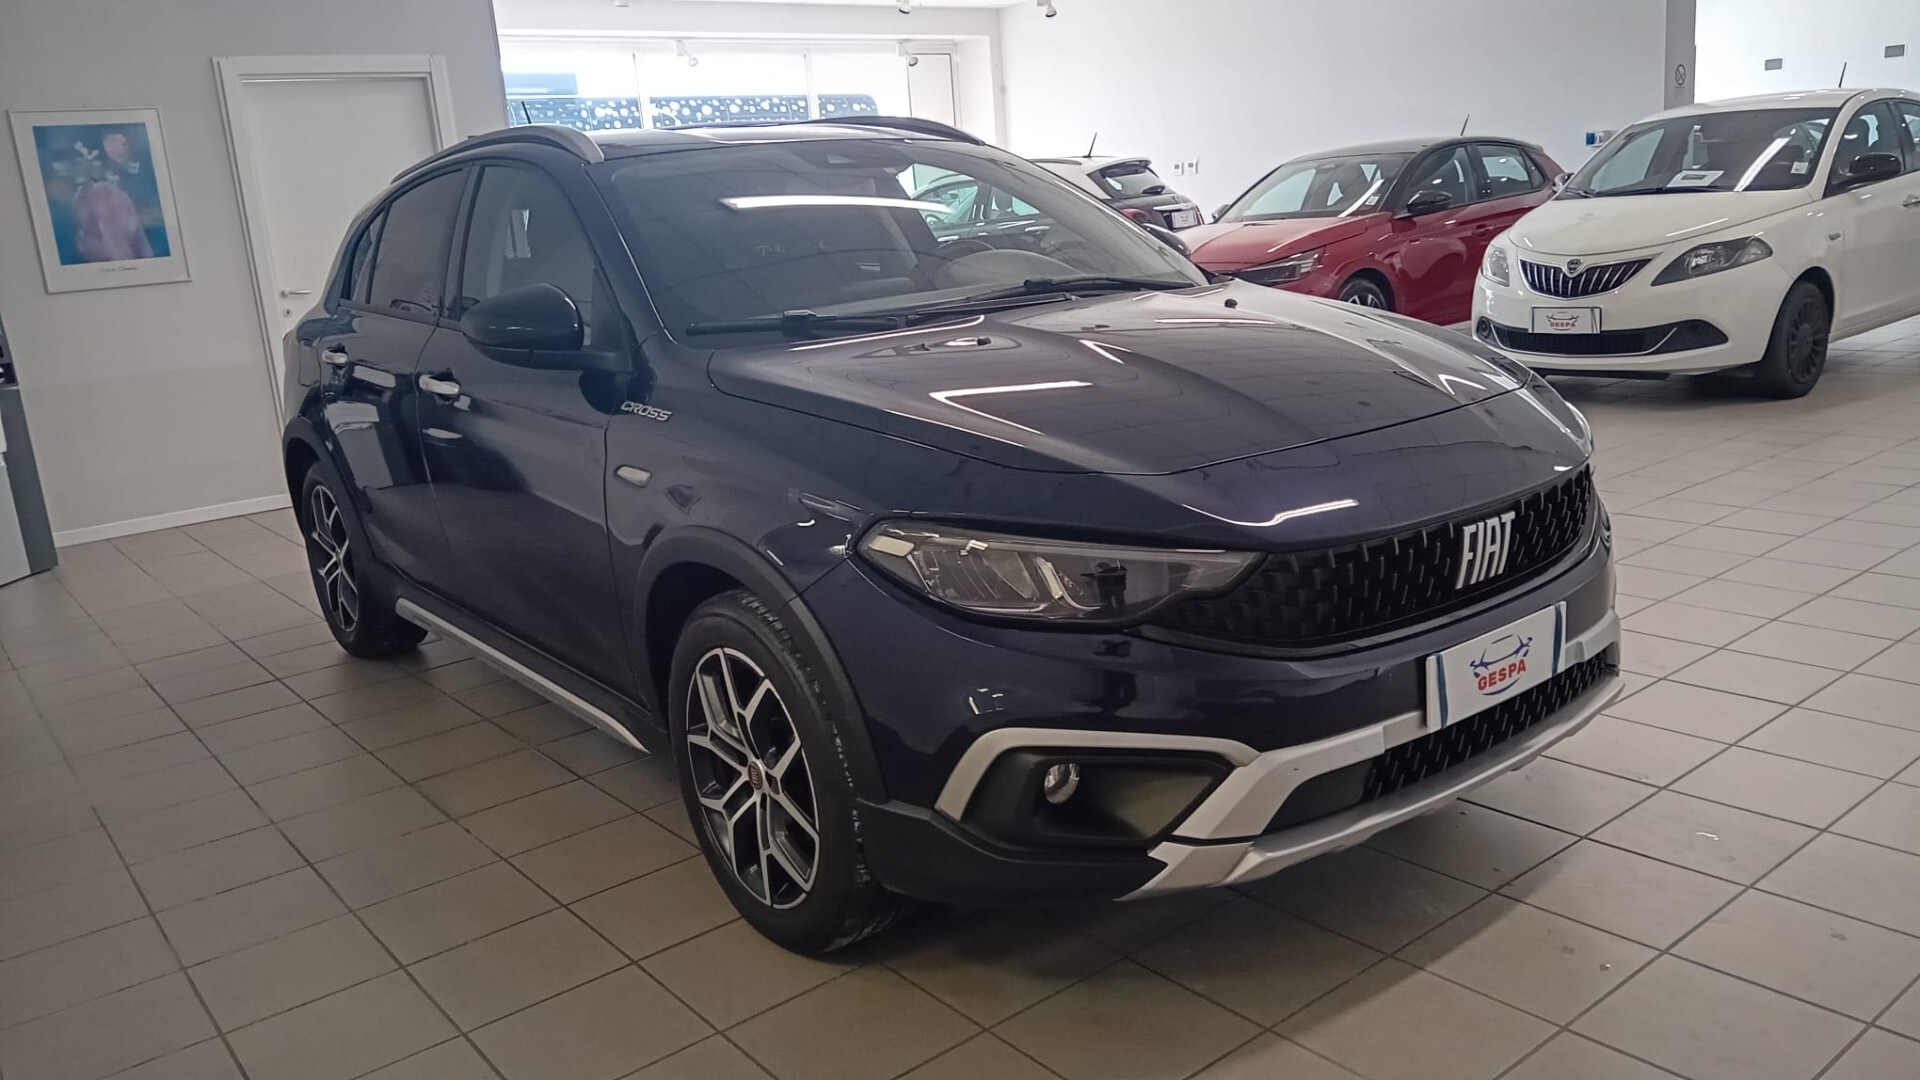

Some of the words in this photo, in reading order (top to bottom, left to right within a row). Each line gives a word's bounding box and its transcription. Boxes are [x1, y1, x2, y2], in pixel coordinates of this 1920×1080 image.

[620, 400, 672, 421] CROSS
[1455, 511, 1516, 590] FIAT
[1477, 659, 1527, 691] GESPA
